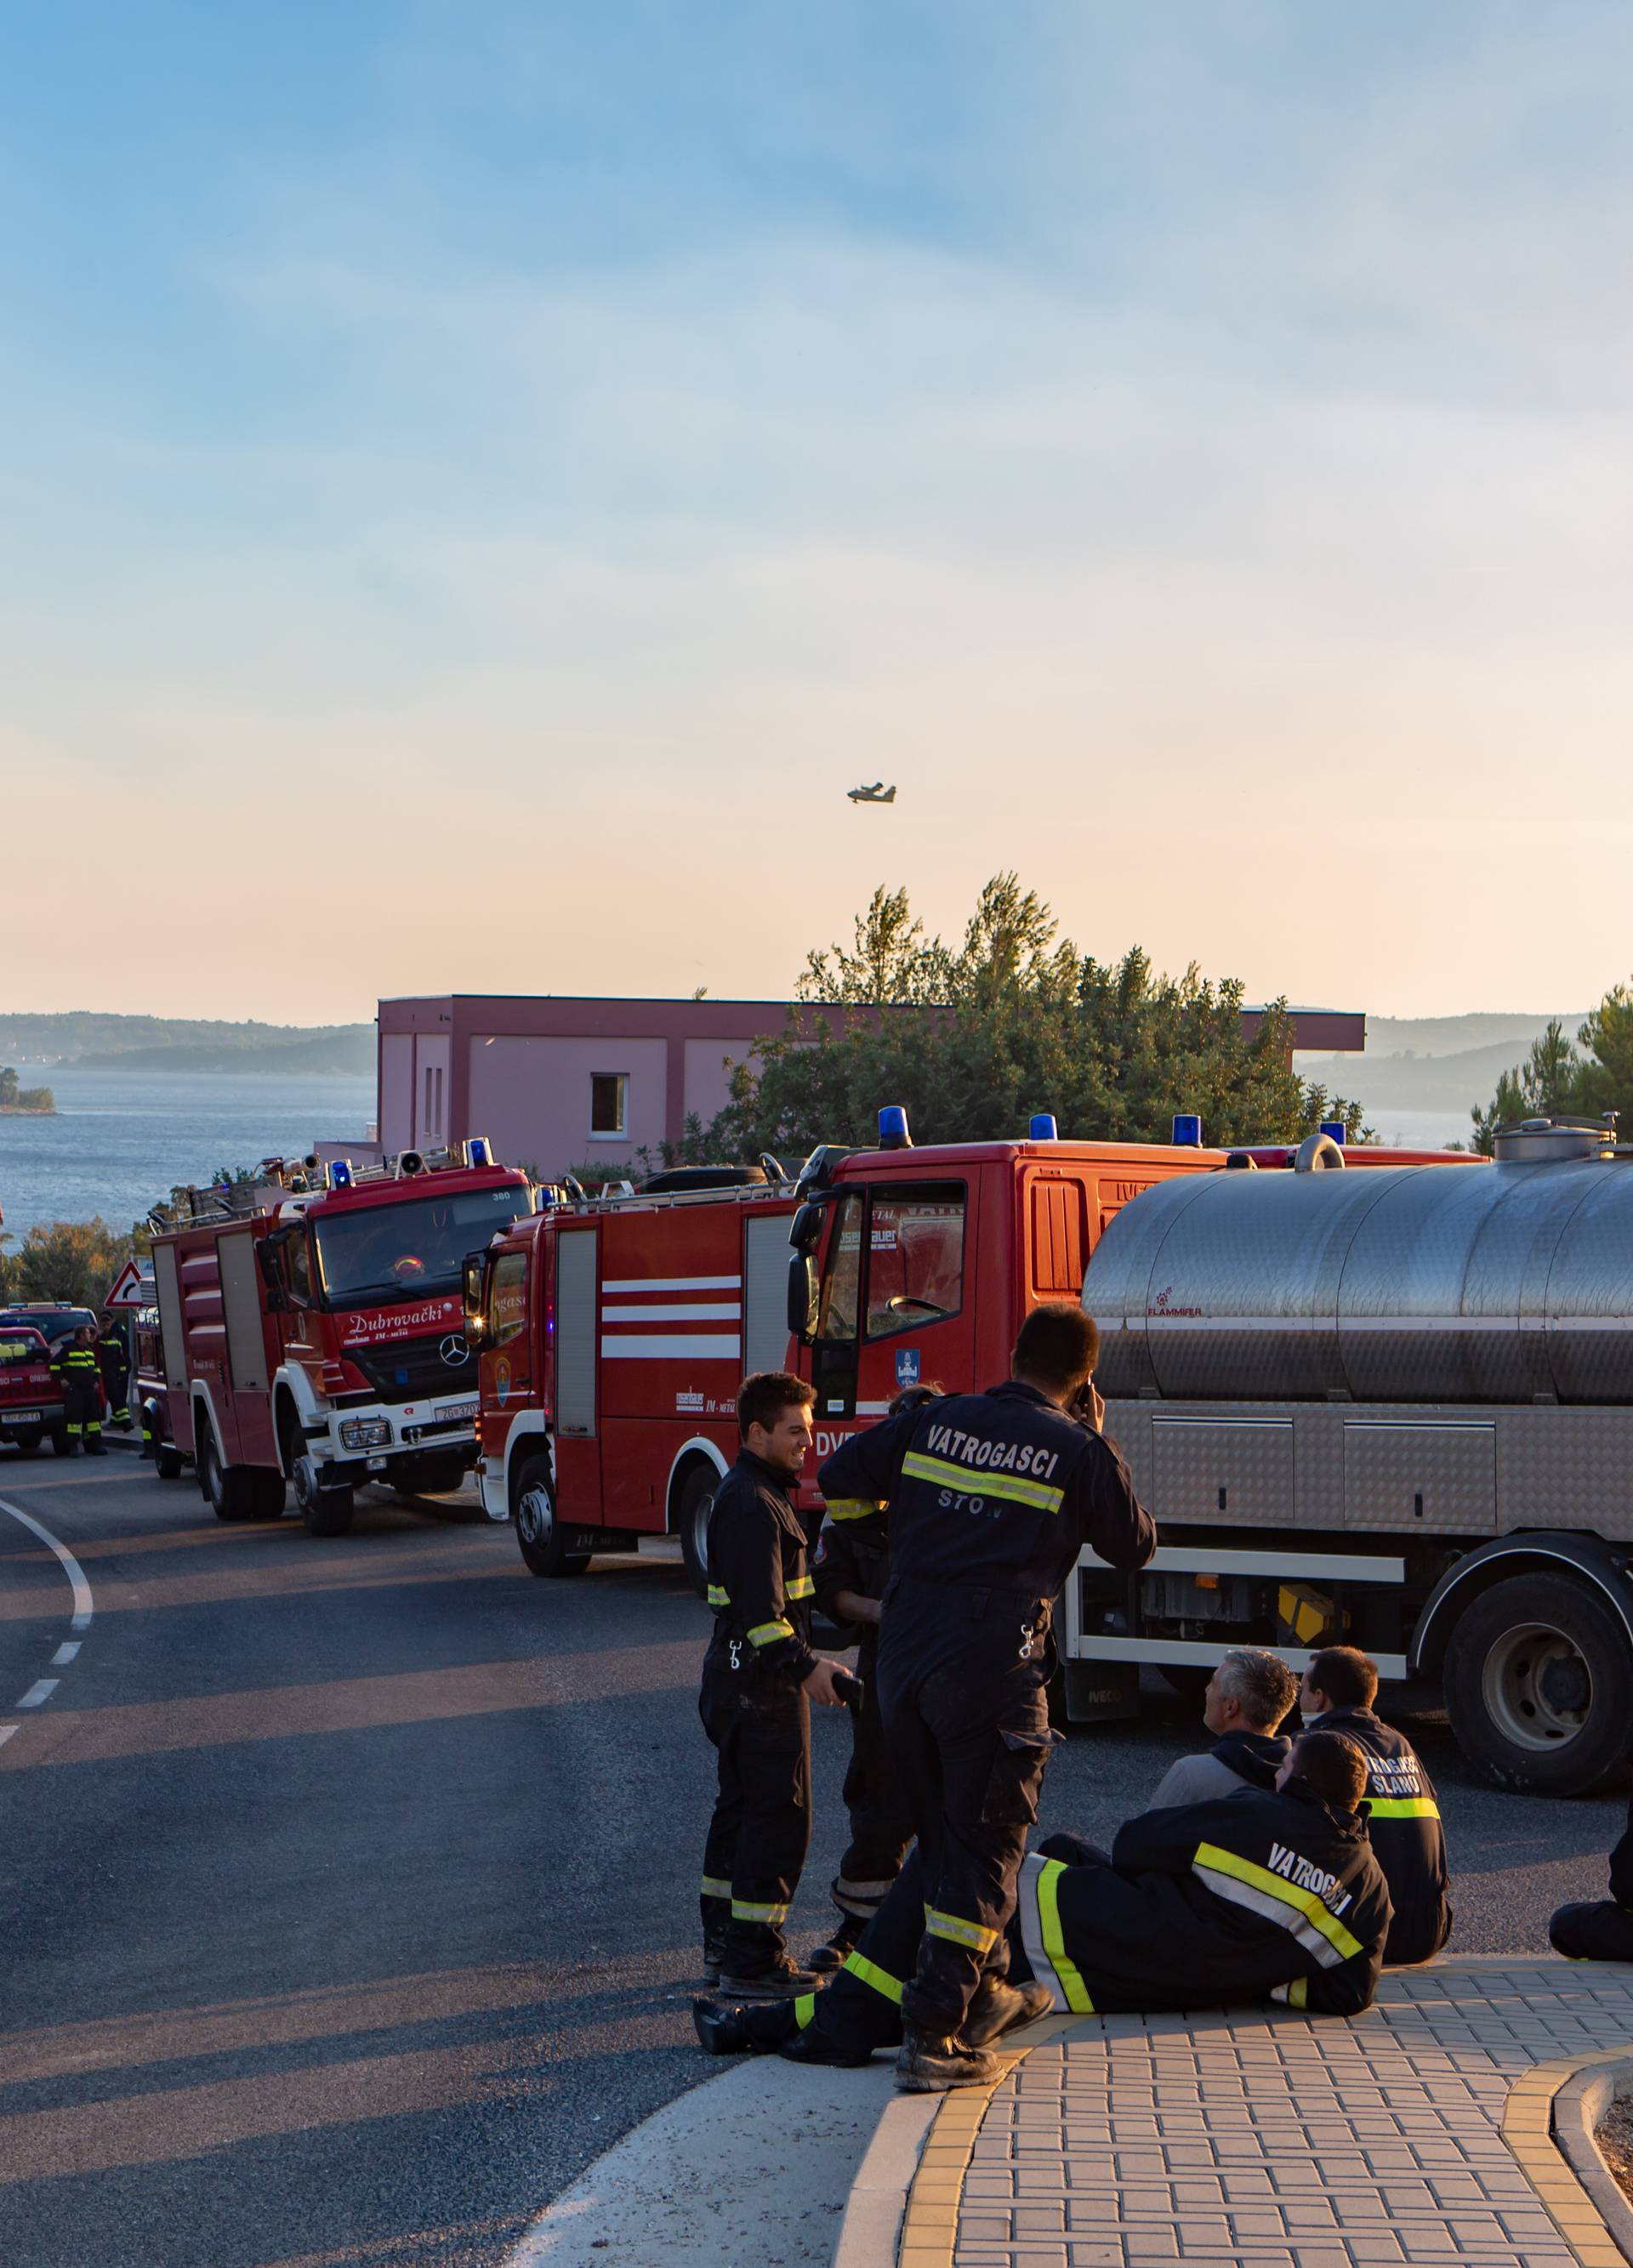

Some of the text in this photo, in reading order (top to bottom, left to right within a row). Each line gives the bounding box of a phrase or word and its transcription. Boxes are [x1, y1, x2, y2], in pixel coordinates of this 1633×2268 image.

[492, 1191, 510, 1202] 380
[350, 1304, 443, 1334] Dubrovački
[1148, 1308, 1202, 1316] FLAMMIFER
[442, 1409, 454, 1420] ZG
[927, 1424, 1059, 1479] VATROGASCI
[1372, 1775, 1420, 1793] SLANO
